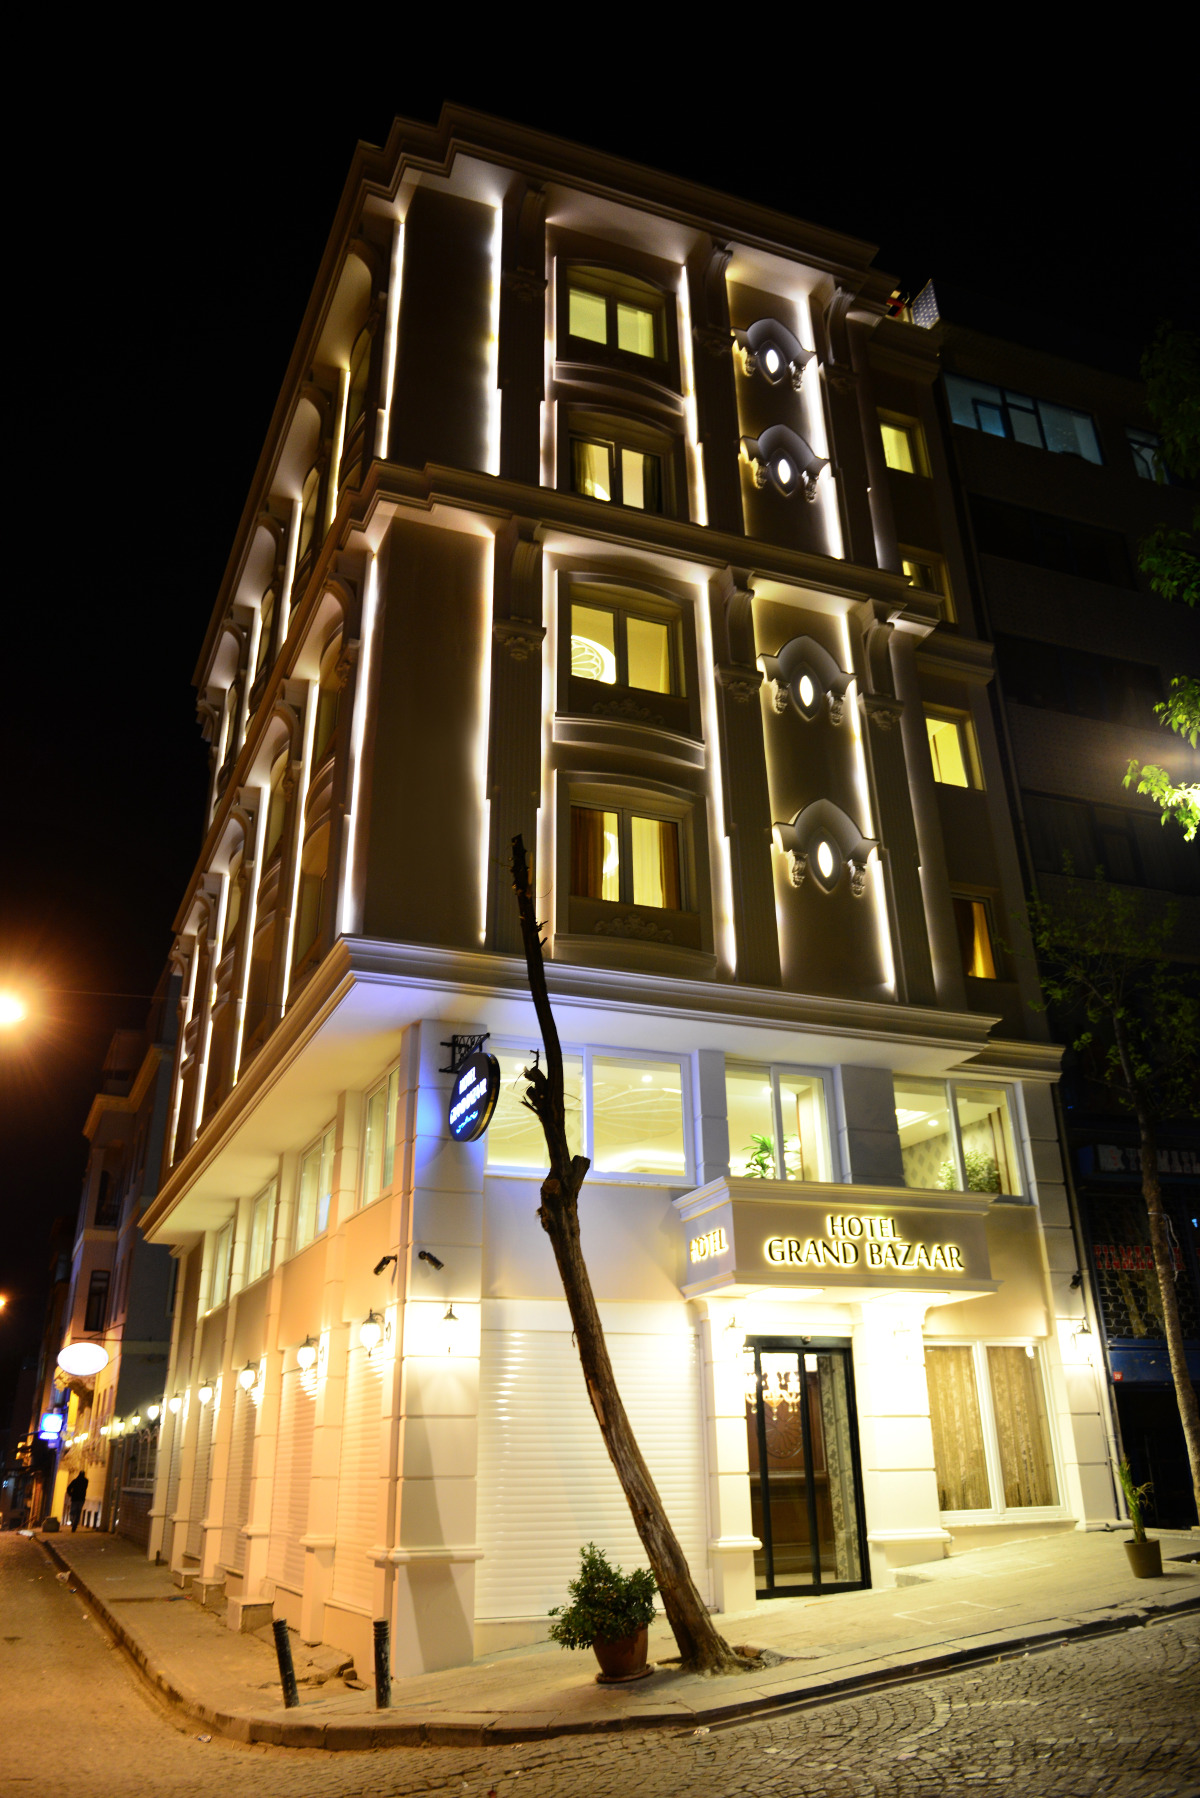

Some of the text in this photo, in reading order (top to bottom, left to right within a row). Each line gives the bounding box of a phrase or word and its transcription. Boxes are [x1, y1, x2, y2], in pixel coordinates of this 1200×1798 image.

[829, 1215, 903, 1239] HOTEL
[689, 1228, 728, 1262] HOTEL
[767, 1238, 965, 1269] GRAND BAZAAR
